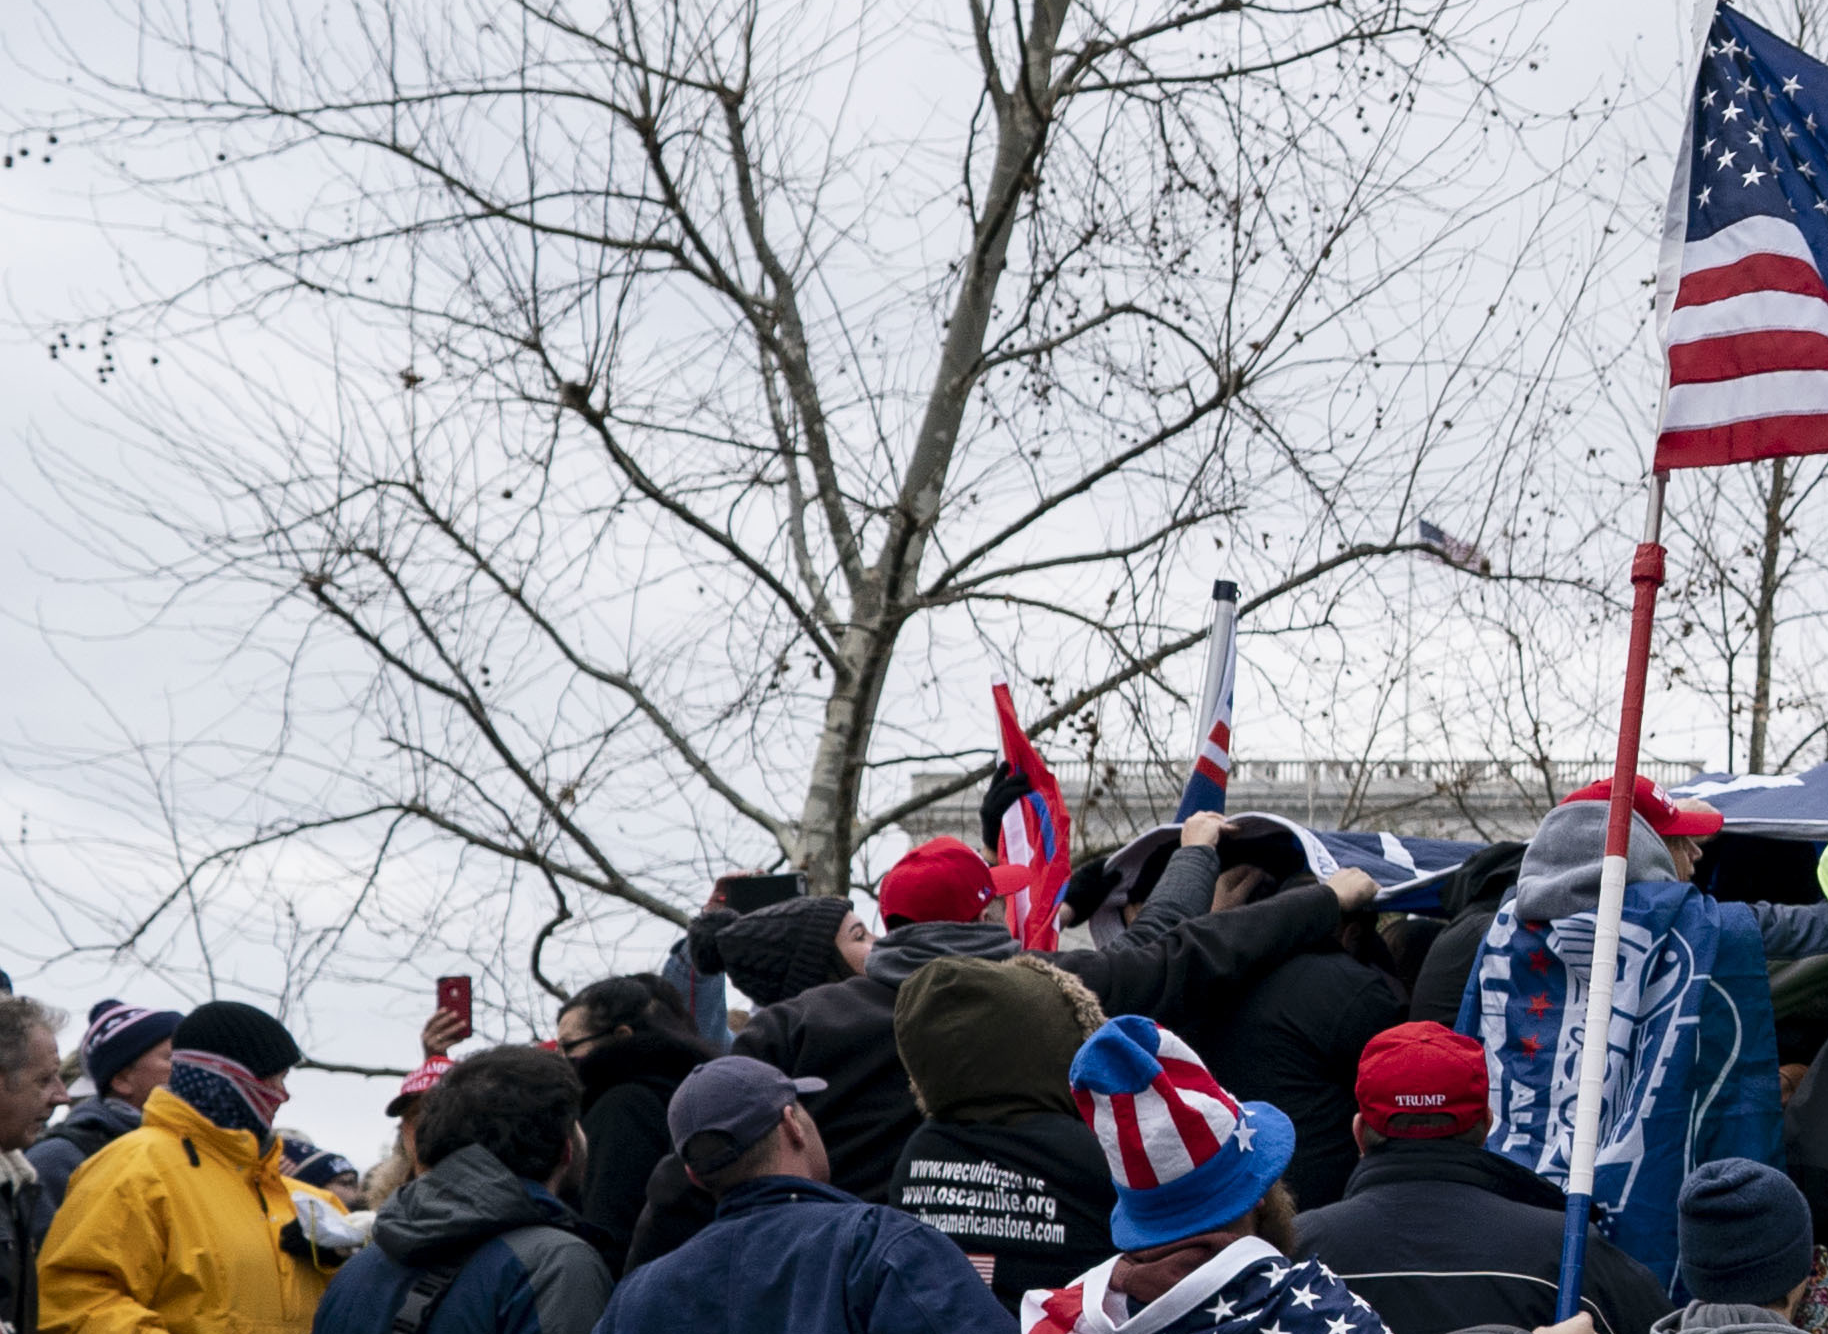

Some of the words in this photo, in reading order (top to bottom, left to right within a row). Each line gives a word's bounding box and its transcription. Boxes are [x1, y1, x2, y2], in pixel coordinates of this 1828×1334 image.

[1395, 1094, 1446, 1106] TRUMP
[1501, 1078, 1537, 1154] ALL
[909, 1159, 1045, 1193] www.wecultivateus
[902, 1185, 1057, 1220] www.oscarnike.org
